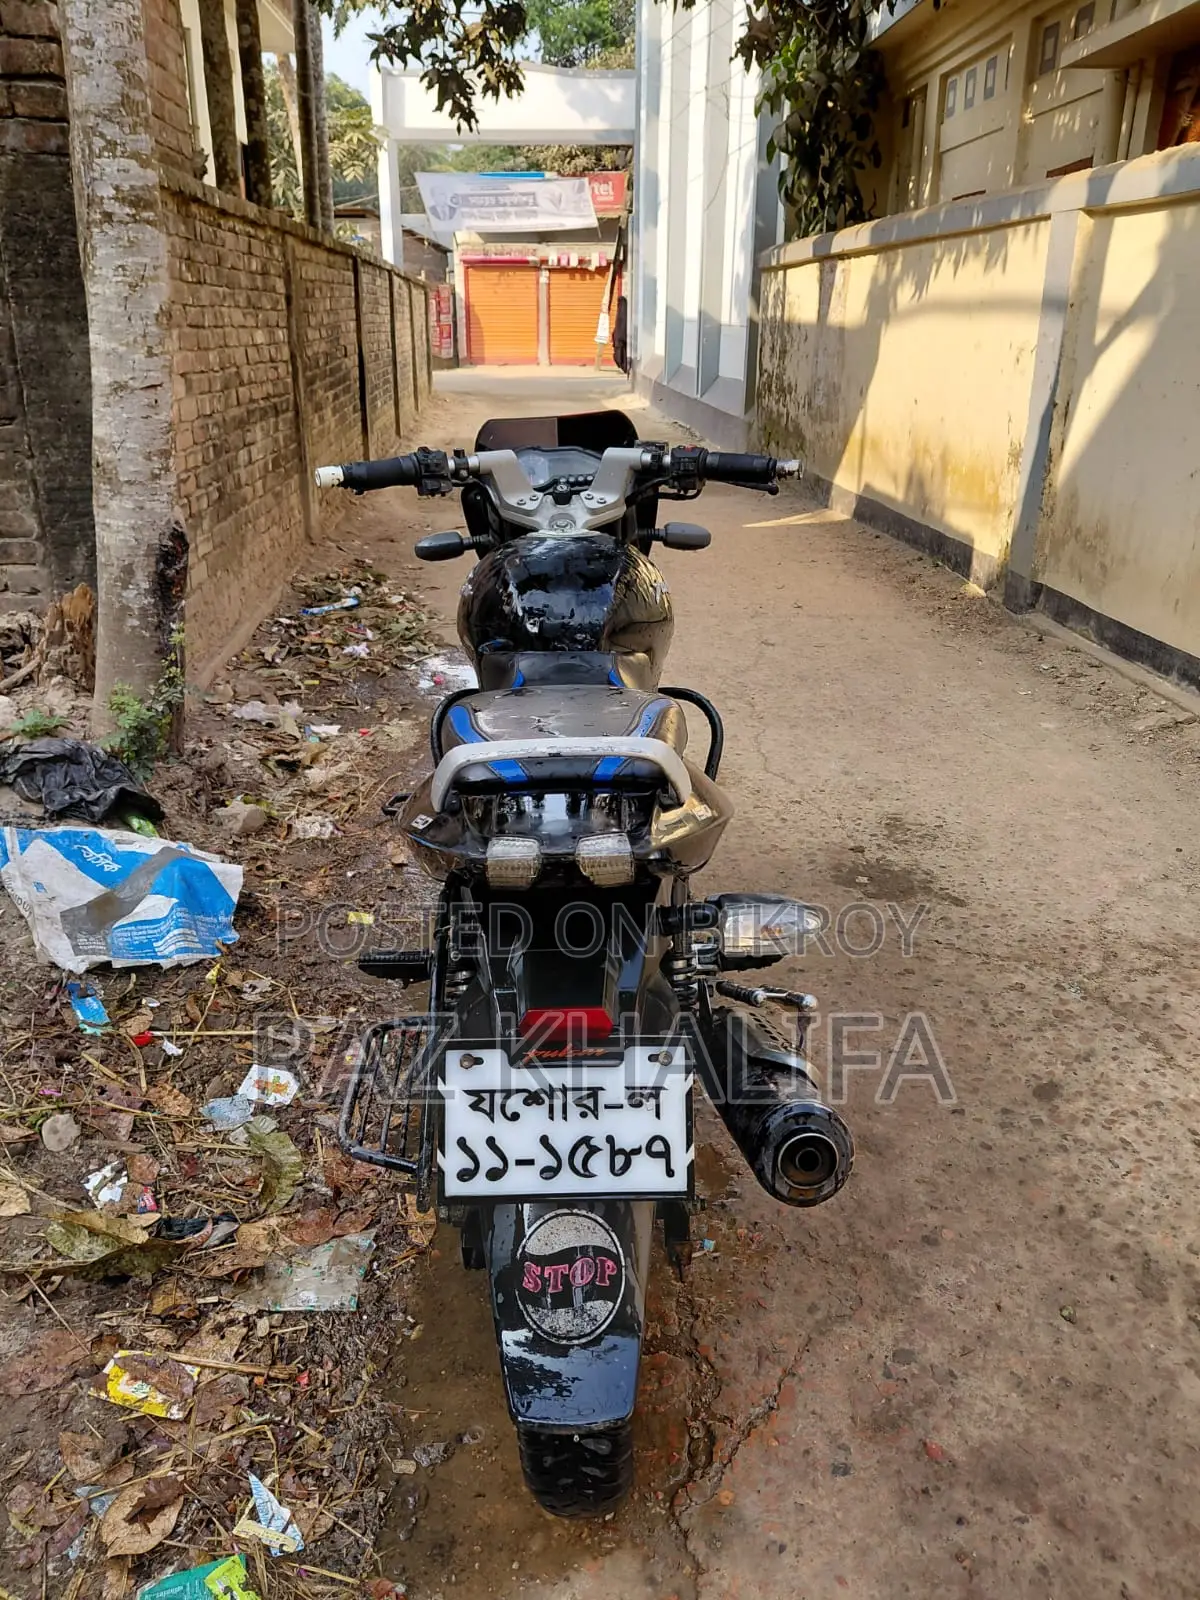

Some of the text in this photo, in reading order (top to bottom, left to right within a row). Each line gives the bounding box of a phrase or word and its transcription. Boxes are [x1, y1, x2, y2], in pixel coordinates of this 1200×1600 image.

[591, 180, 614, 195] tel
[456, 1134, 675, 1183] ১১-১৫৮৭
[522, 1256, 618, 1294] STOP
